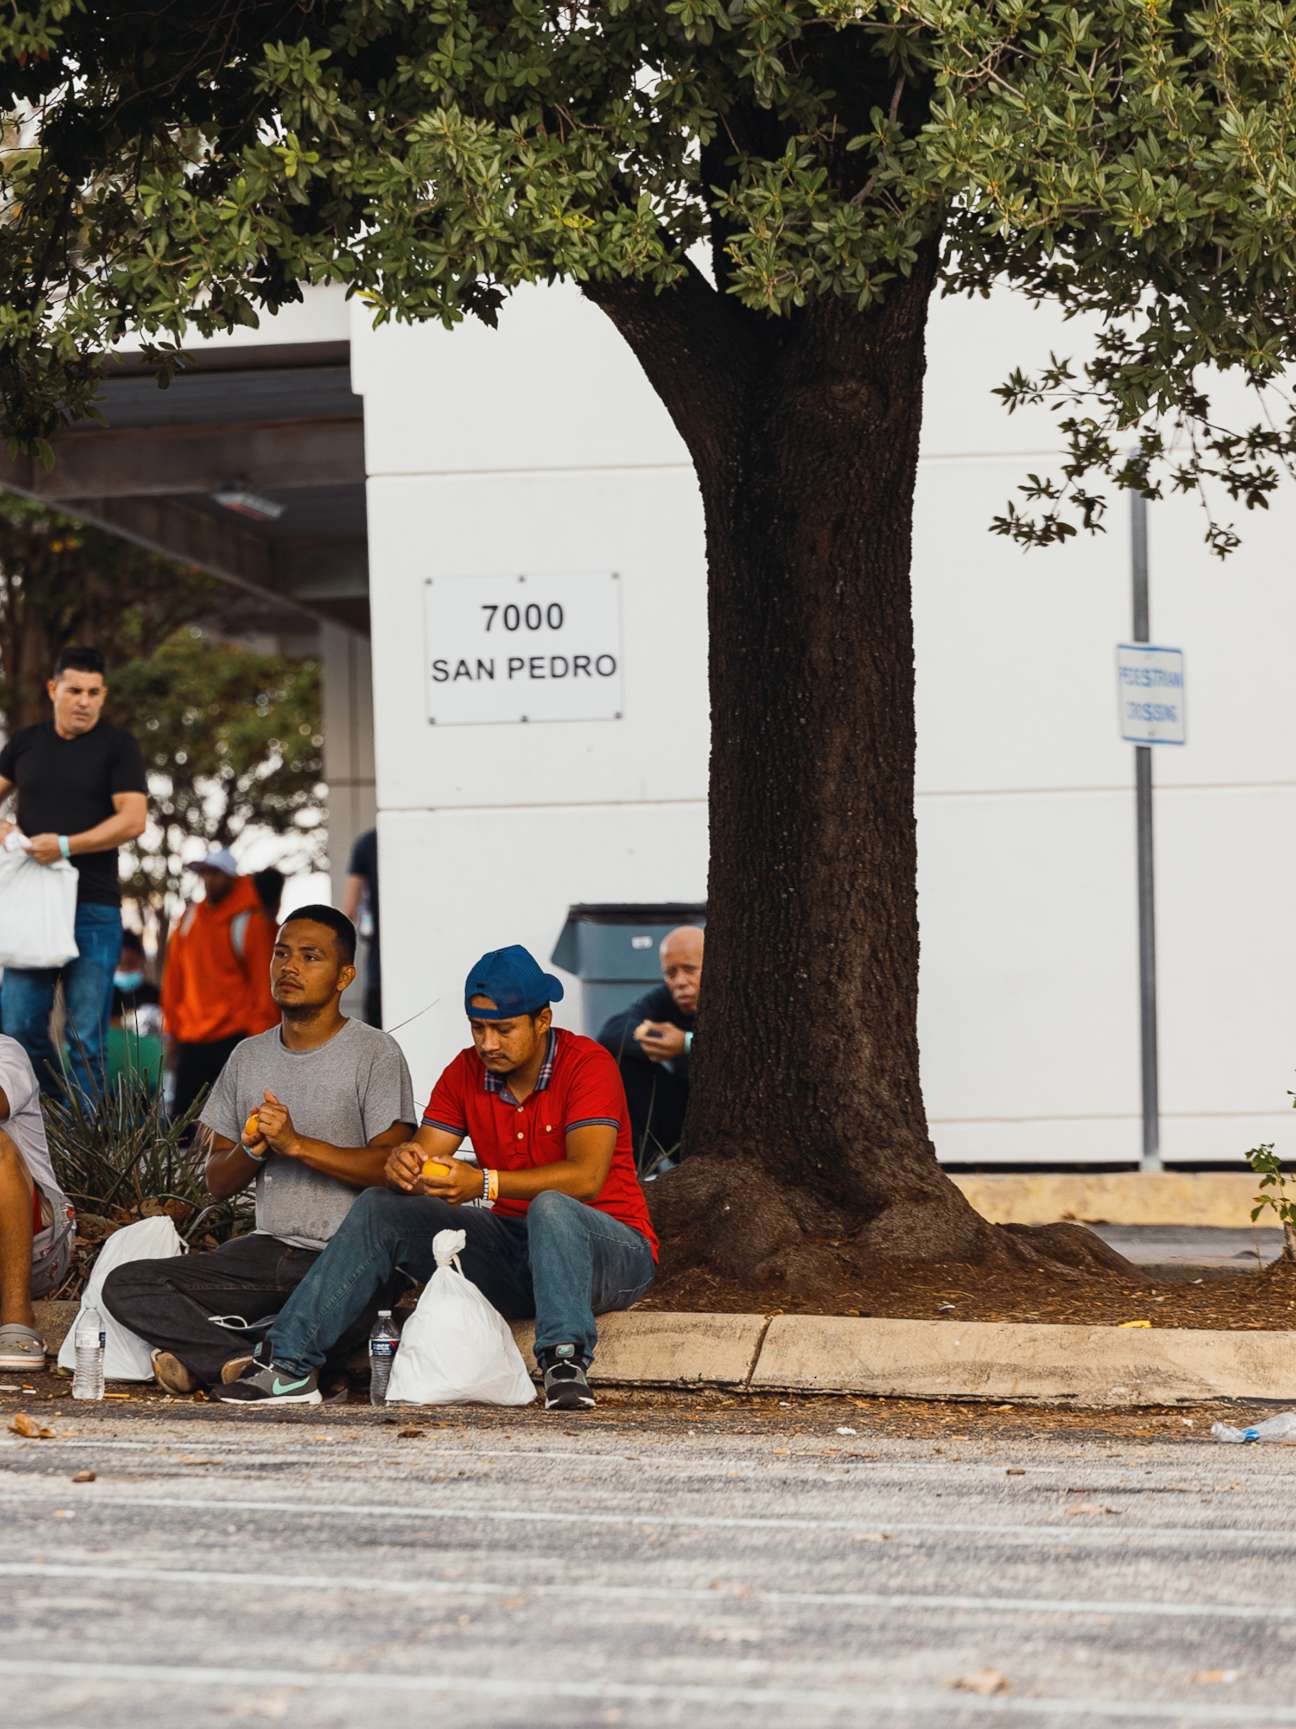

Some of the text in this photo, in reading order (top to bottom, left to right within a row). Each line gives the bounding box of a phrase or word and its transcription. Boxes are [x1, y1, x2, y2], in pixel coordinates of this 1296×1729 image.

[481, 602, 564, 632] 7000
[432, 654, 617, 682] SAN PEDRO
